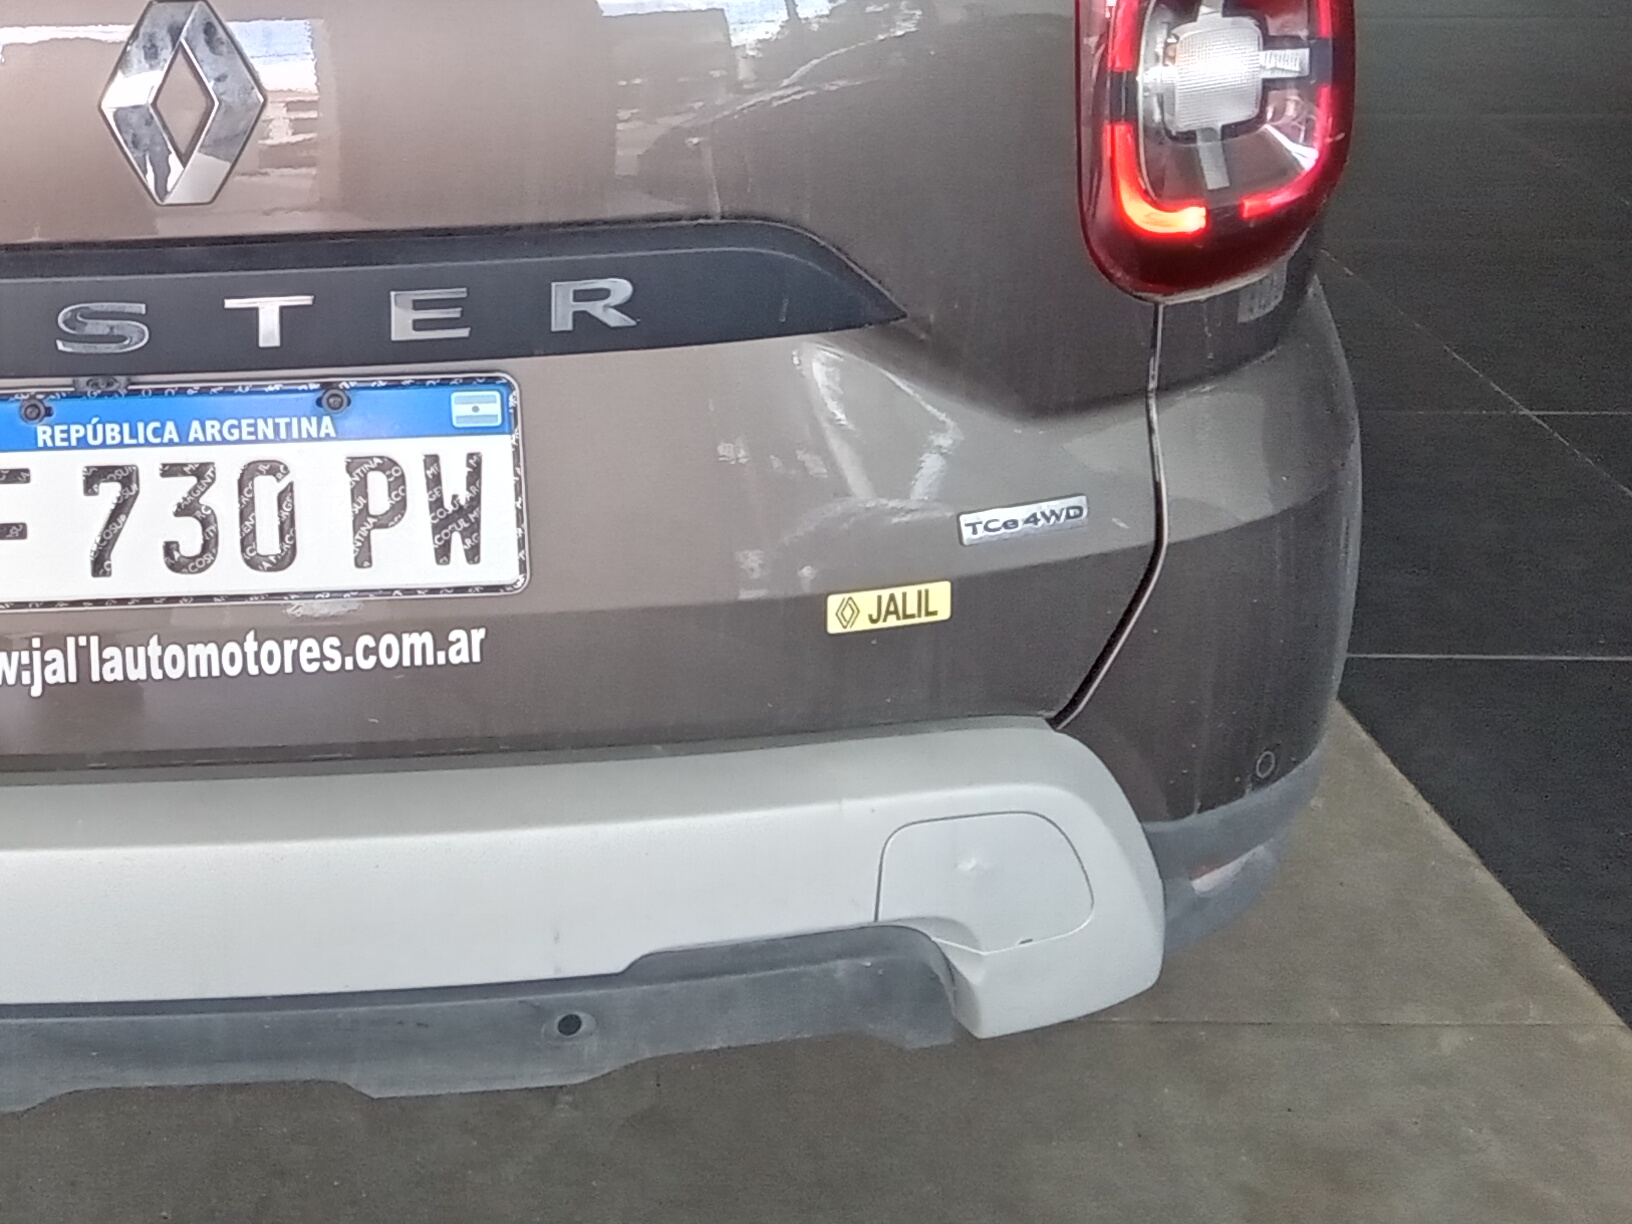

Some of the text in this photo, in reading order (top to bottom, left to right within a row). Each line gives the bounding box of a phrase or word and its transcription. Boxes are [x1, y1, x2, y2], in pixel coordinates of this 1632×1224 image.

[36, 415, 337, 448] REPÚBLICA ARGENTINA
[82, 460, 297, 578] 730
[345, 452, 483, 569] PW
[867, 588, 939, 625] JALIL
